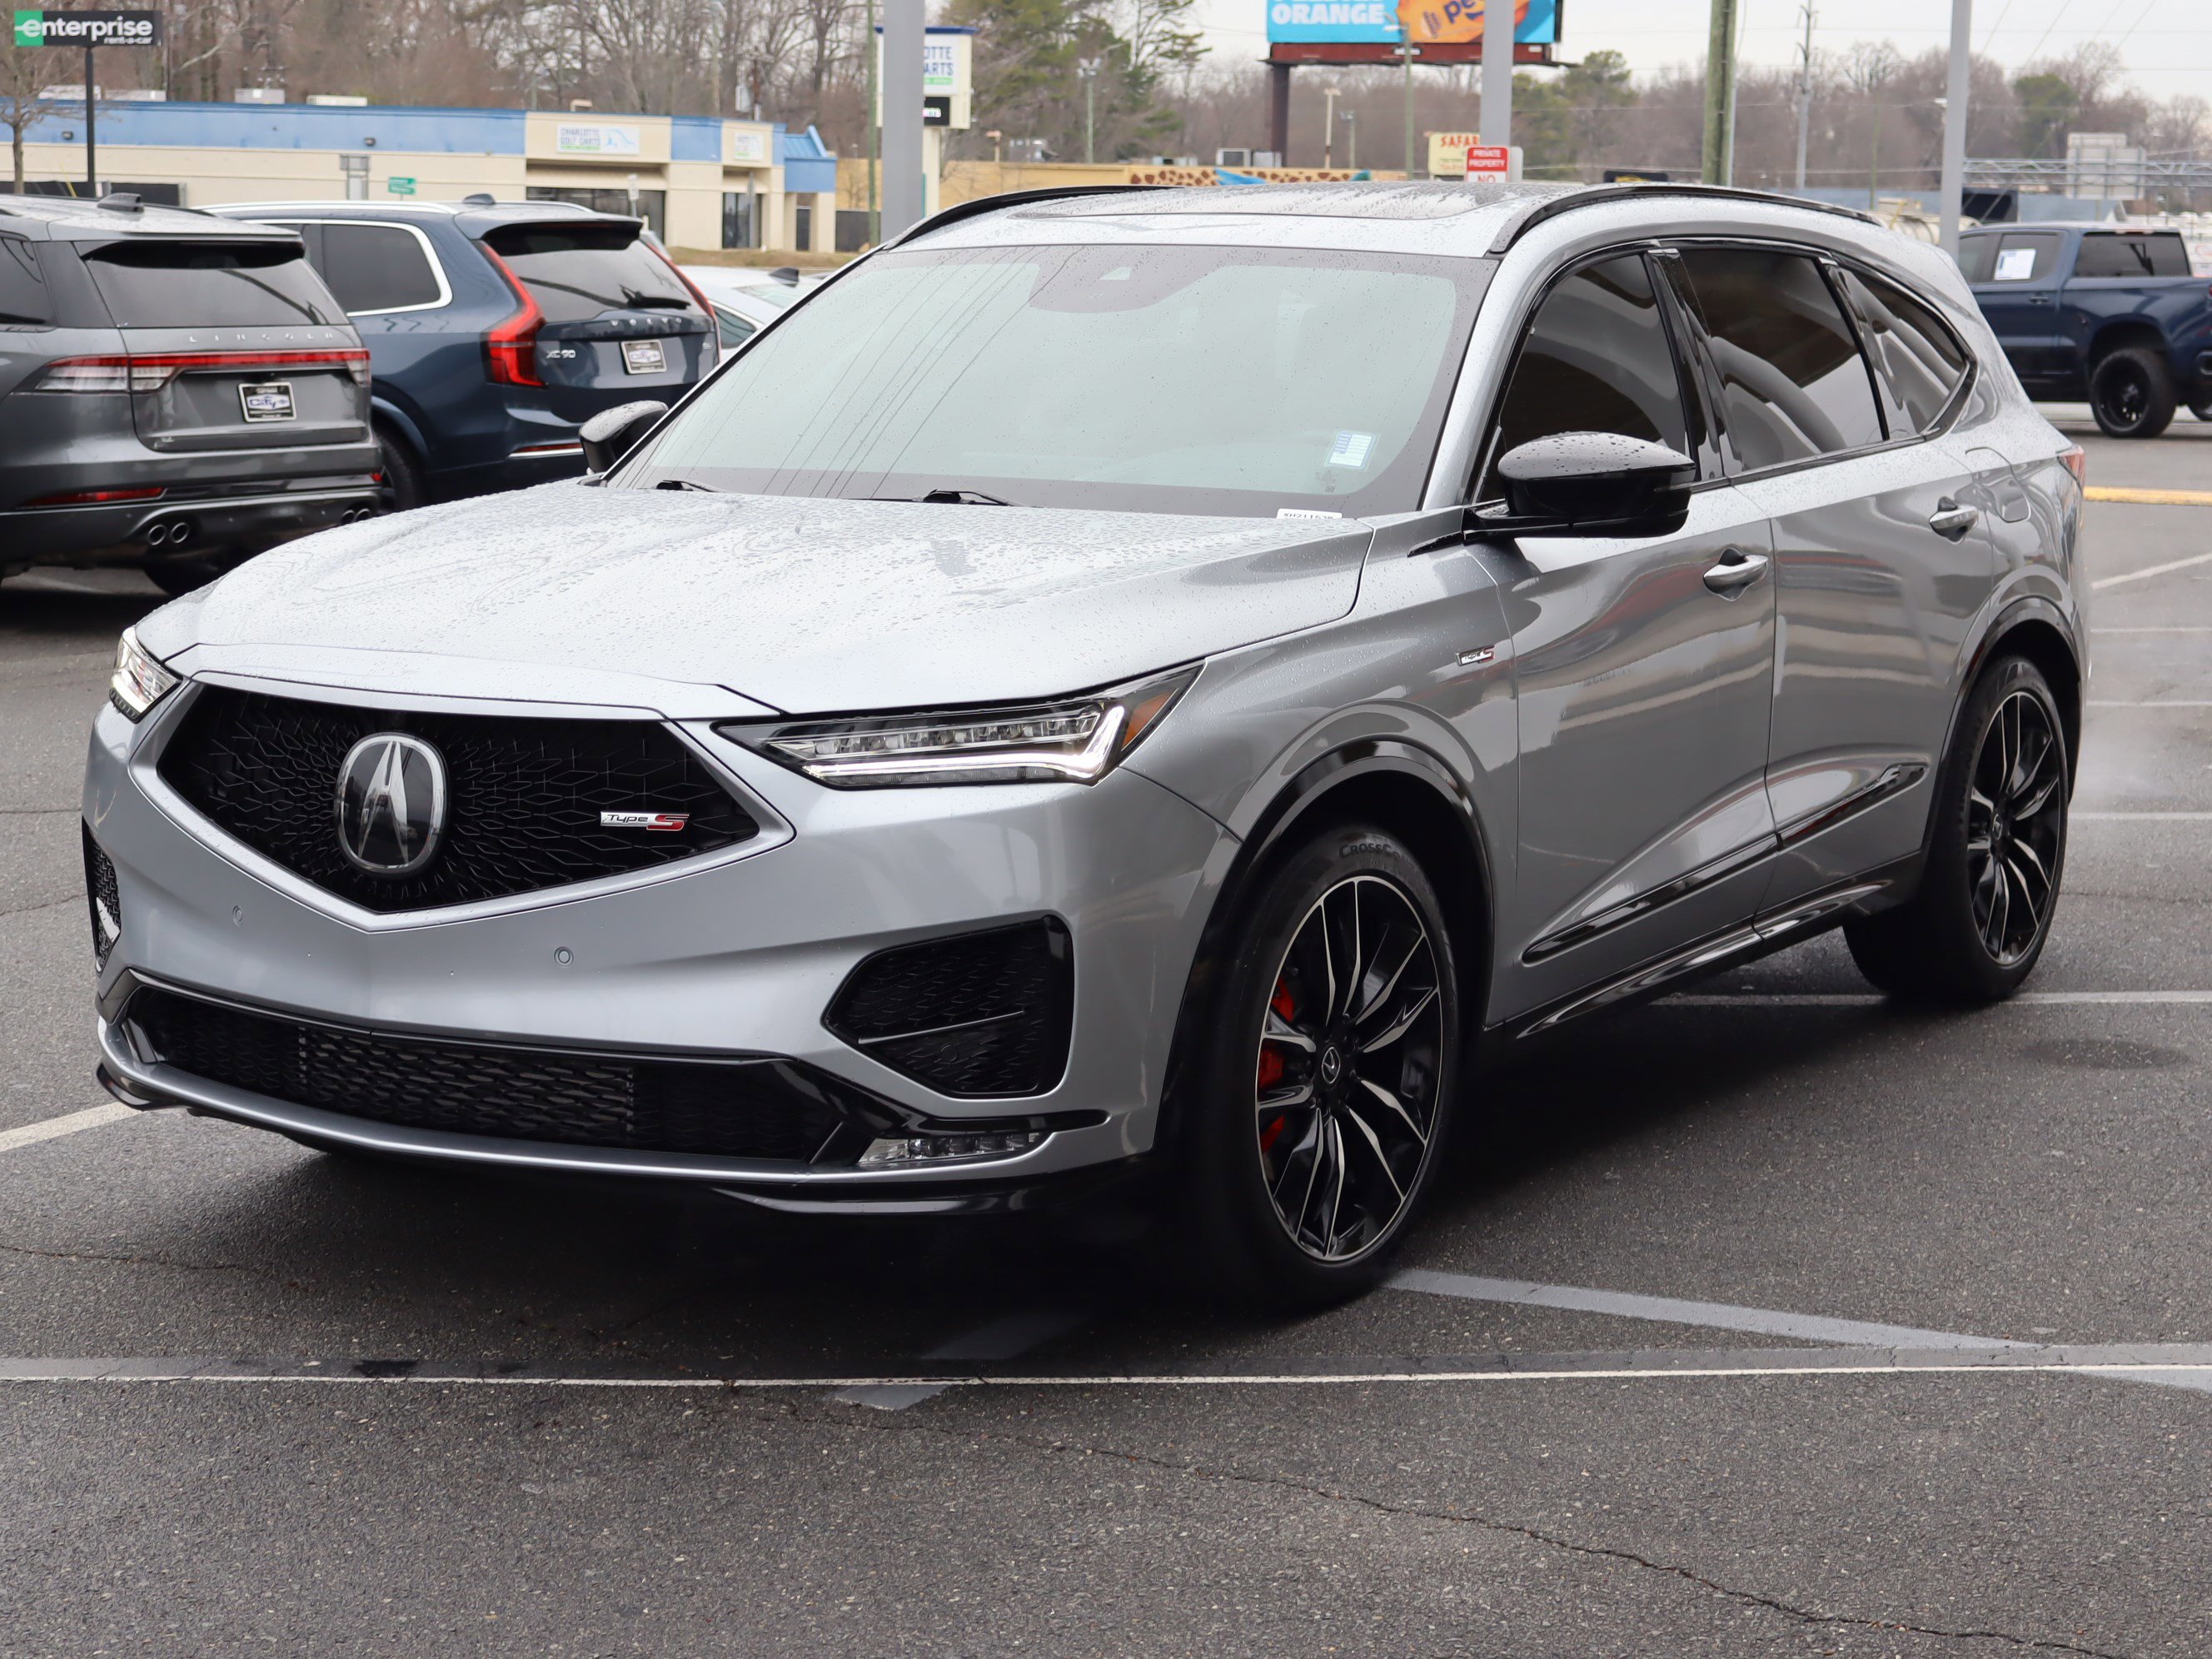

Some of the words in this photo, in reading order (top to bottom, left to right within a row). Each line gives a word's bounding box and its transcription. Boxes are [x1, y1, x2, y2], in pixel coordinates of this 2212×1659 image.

[1272, 3, 1385, 25] ORANGE
[14, 16, 153, 41] enterprise
[924, 46, 952, 60] OTTE
[924, 62, 954, 76] ARTS
[1440, 135, 1479, 147] SAFAR
[1469, 159, 1506, 167] PROPERTY
[1477, 174, 1497, 182] NO
[606, 814, 649, 824] Type
[645, 813, 690, 831] S
